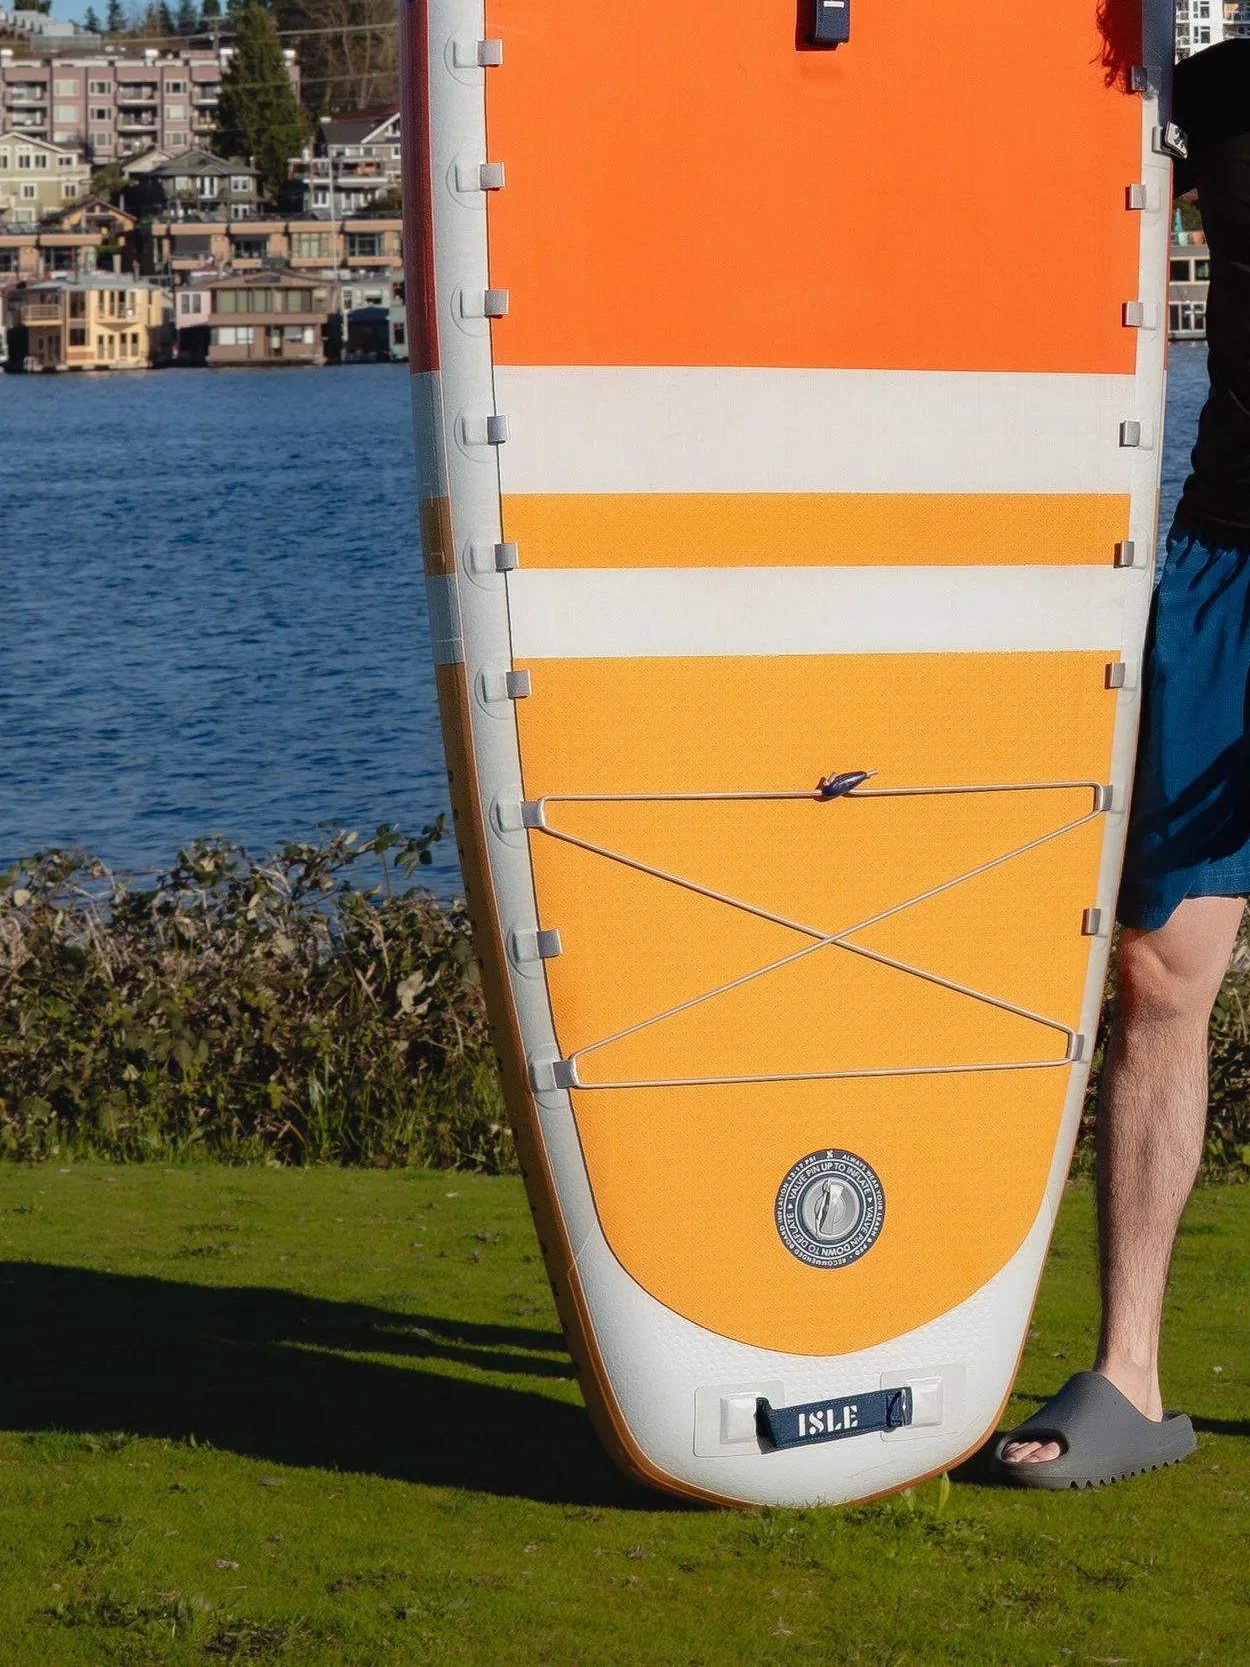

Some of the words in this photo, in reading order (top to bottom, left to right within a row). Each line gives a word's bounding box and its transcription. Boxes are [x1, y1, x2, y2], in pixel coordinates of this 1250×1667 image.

[788, 1174, 808, 1200] VALVE
[806, 1165, 821, 1177] PIN
[821, 1162, 833, 1171] UP
[834, 1163, 846, 1172] TO
[846, 1167, 872, 1195] INFLATE
[842, 1154, 867, 1171] ALWAYS
[865, 1170, 879, 1189] WEAR
[876, 1190, 884, 1211] YOUR
[777, 1183, 789, 1223] INFLATION
[786, 1212, 809, 1249] DEFLATE
[860, 1206, 874, 1234] VALVE
[779, 1225, 796, 1249] BOARD
[808, 1245, 820, 1256] TO
[821, 1244, 851, 1256] DOWN
[850, 1233, 864, 1247] PIN
[794, 1249, 847, 1266] RECOMMENDED
[798, 1405, 858, 1437] ISLE
